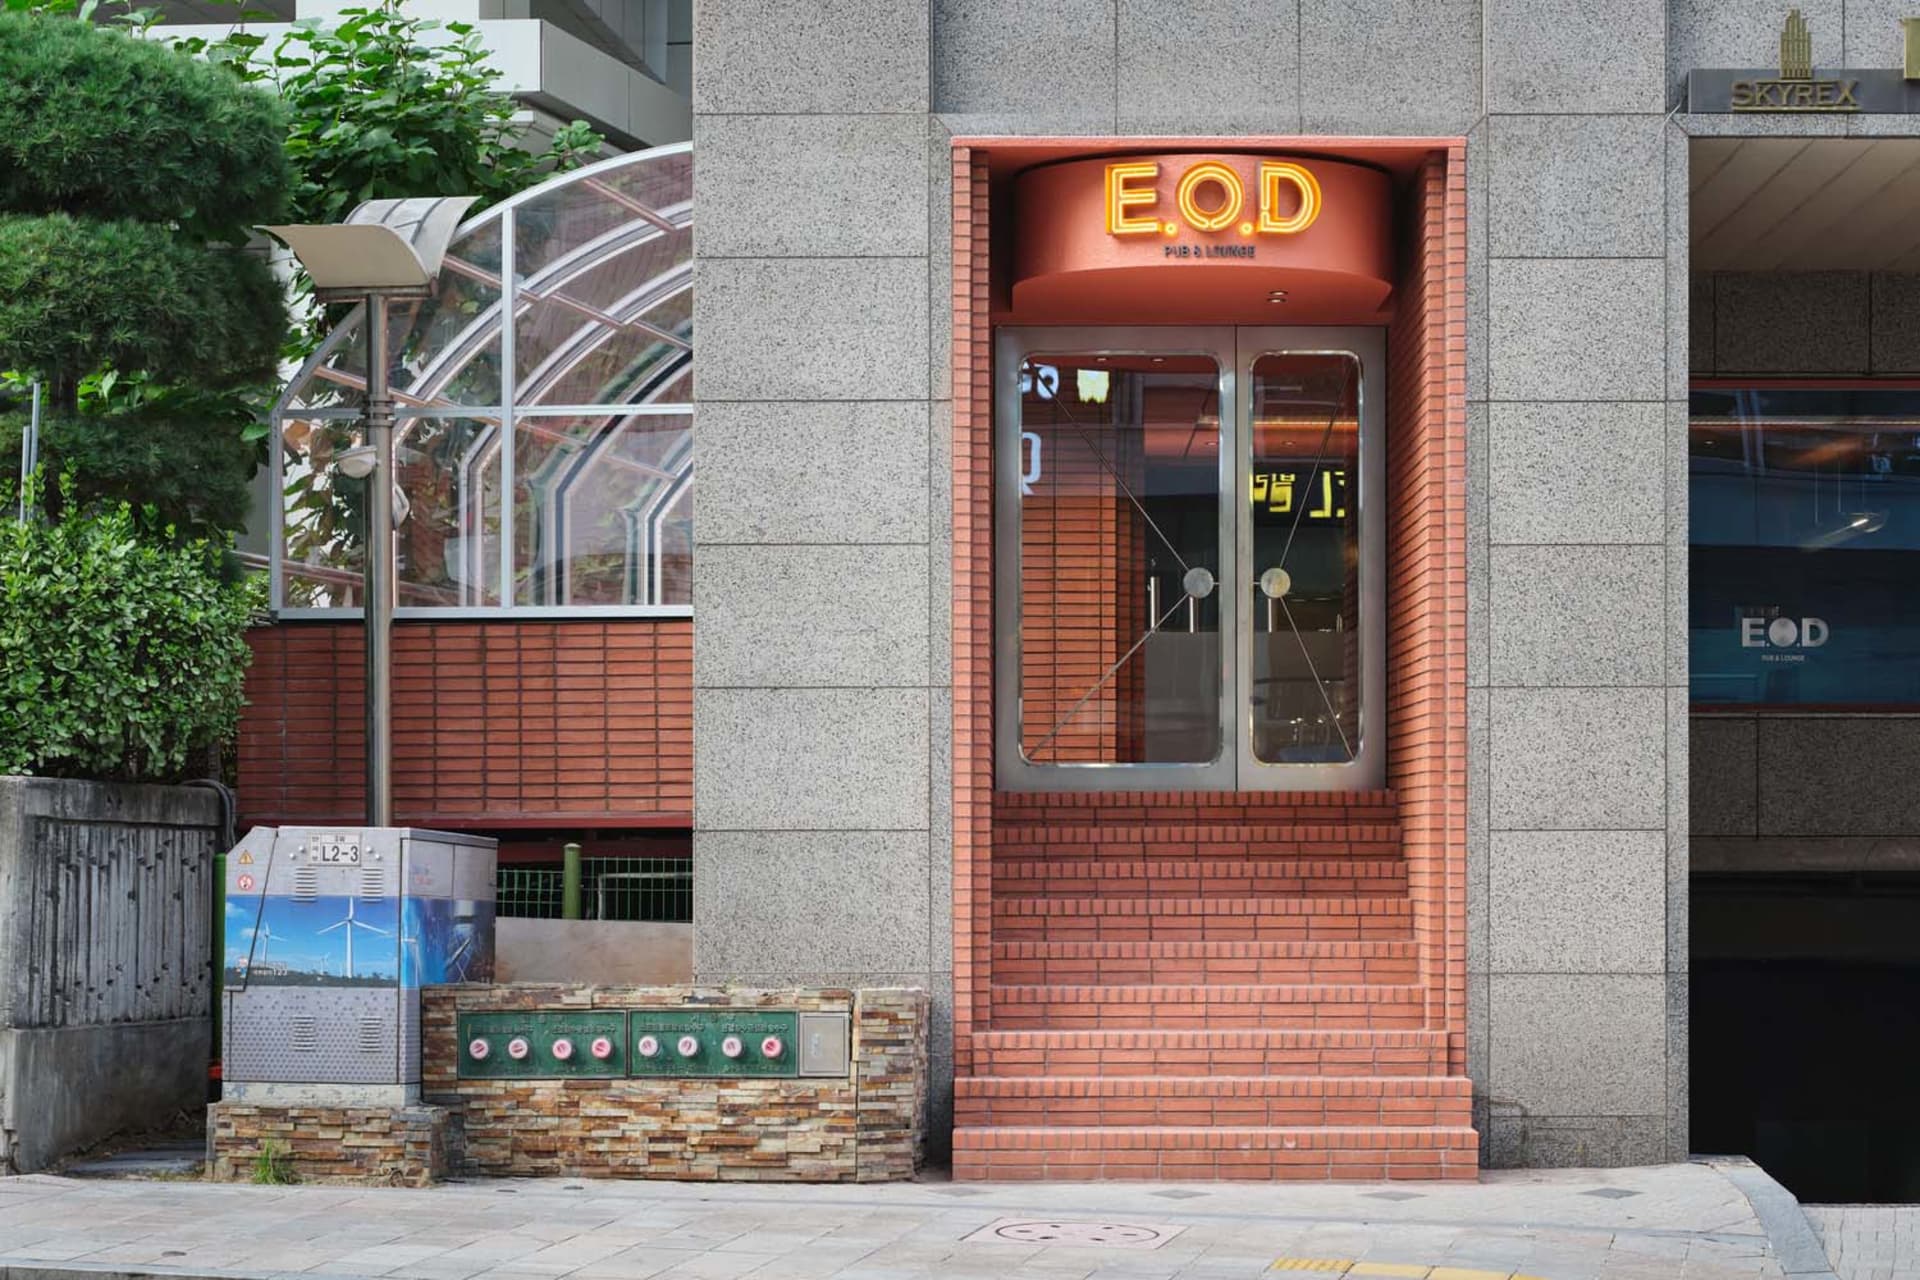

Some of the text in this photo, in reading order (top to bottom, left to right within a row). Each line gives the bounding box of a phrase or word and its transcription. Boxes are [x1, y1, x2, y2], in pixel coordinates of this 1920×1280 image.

[1732, 79, 1859, 106] SKYREX
[1105, 160, 1322, 237] E.O.D
[1164, 245, 1190, 258] PUB
[1205, 245, 1256, 258] LOUNGE
[1742, 617, 1829, 648] E.O.D
[322, 845, 359, 862] L2-3
